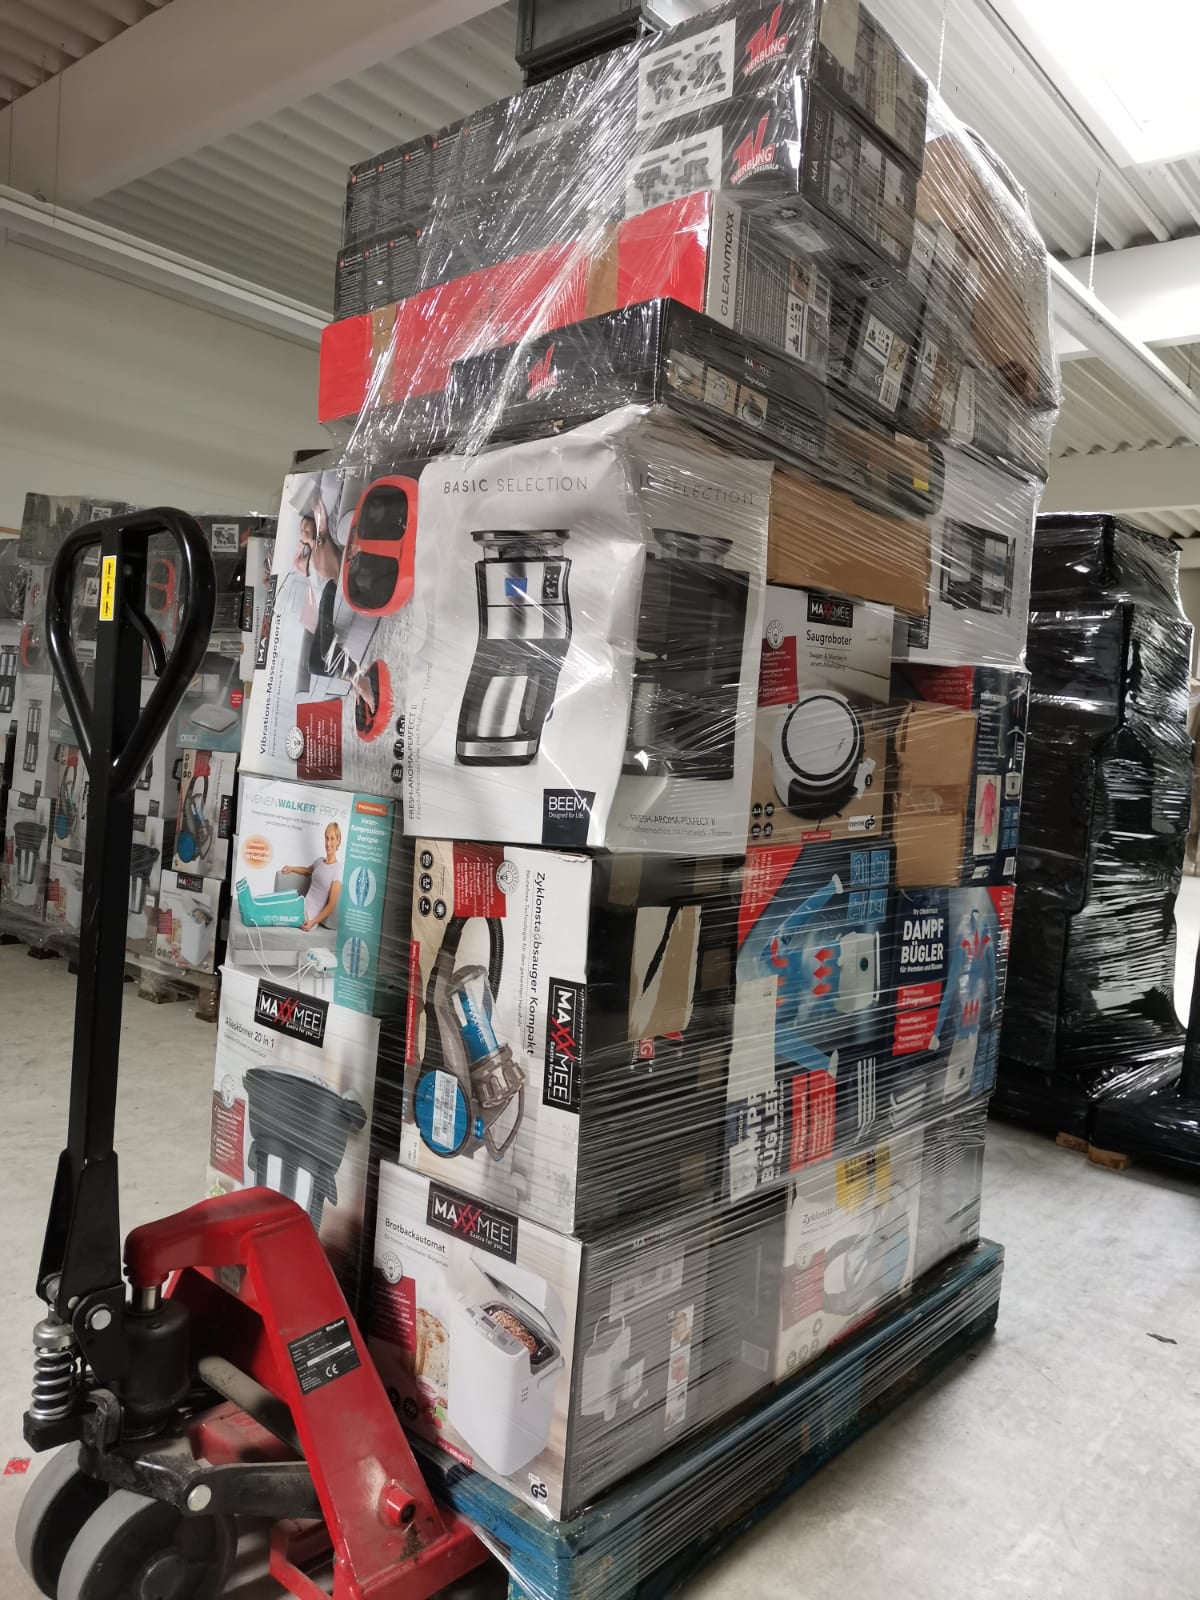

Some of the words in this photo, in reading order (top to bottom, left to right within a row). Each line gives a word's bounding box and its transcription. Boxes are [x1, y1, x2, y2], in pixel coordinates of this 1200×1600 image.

[743, 33, 788, 77] WERBUNG
[730, 144, 775, 184] WERBUNG
[720, 210, 735, 317] CLEANmaxx
[443, 479, 489, 494] BASIC
[496, 476, 588, 493] SELECTION
[806, 629, 852, 646] Saugroboter
[549, 796, 588, 811] BEEM
[903, 918, 944, 941] DAMPF
[901, 941, 944, 964] BÜGLER
[260, 994, 321, 1032] MAXXMEE
[525, 996, 540, 1056] Kompakt
[254, 1031, 262, 1043] 20
[263, 1035, 269, 1047] in
[270, 1038, 275, 1048] 1
[551, 989, 577, 1100] MAXXMEE
[434, 1197, 510, 1246] MAXXMEE
[385, 1217, 446, 1254] Brotbackautomat
[485, 1236, 493, 1246] for
[325, 1363, 340, 1378] CE
[530, 1483, 548, 1499] GS
